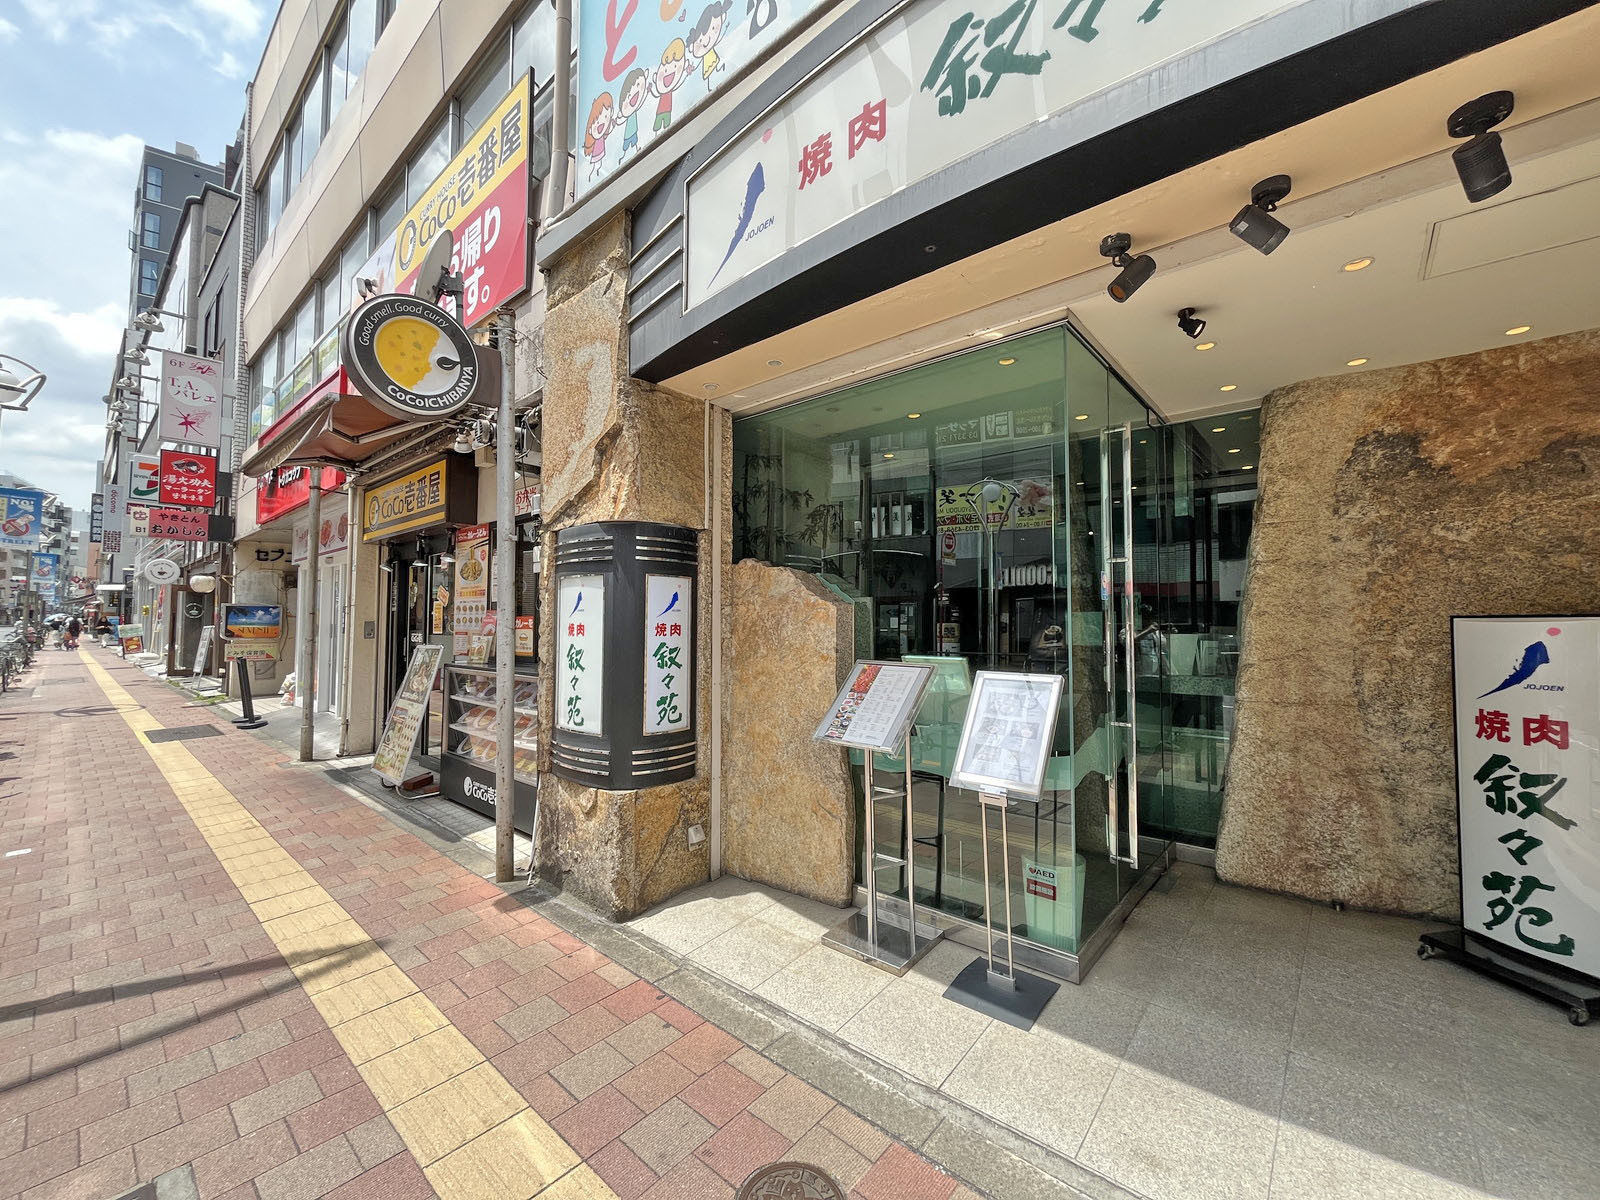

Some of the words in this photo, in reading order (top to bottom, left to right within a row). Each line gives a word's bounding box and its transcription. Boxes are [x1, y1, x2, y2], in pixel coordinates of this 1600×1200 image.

[798, 98, 887, 190] 焼肉
[745, 216, 775, 242] JOJOEN
[359, 318, 374, 346] Good
[371, 303, 396, 324] smell.
[395, 302, 423, 314] Good
[424, 309, 449, 328] curry
[169, 359, 186, 368] 6F
[174, 390, 217, 403] バレエ
[164, 485, 212, 495] マーラータン
[381, 470, 441, 519] CoCo壱番屋
[159, 513, 201, 524] やきとん
[151, 525, 207, 537] おかしら
[568, 622, 585, 637] 焼肉
[655, 622, 682, 637] 焼肉
[566, 643, 586, 726] 叙々苑
[653, 641, 683, 726] 叙々苑
[1523, 683, 1565, 692] JOJOEN
[1474, 707, 1570, 750] 焼肉
[473, 786, 496, 806] CoCo壱
[1473, 753, 1580, 957] 叙々苑
[1035, 869, 1055, 879] AED
